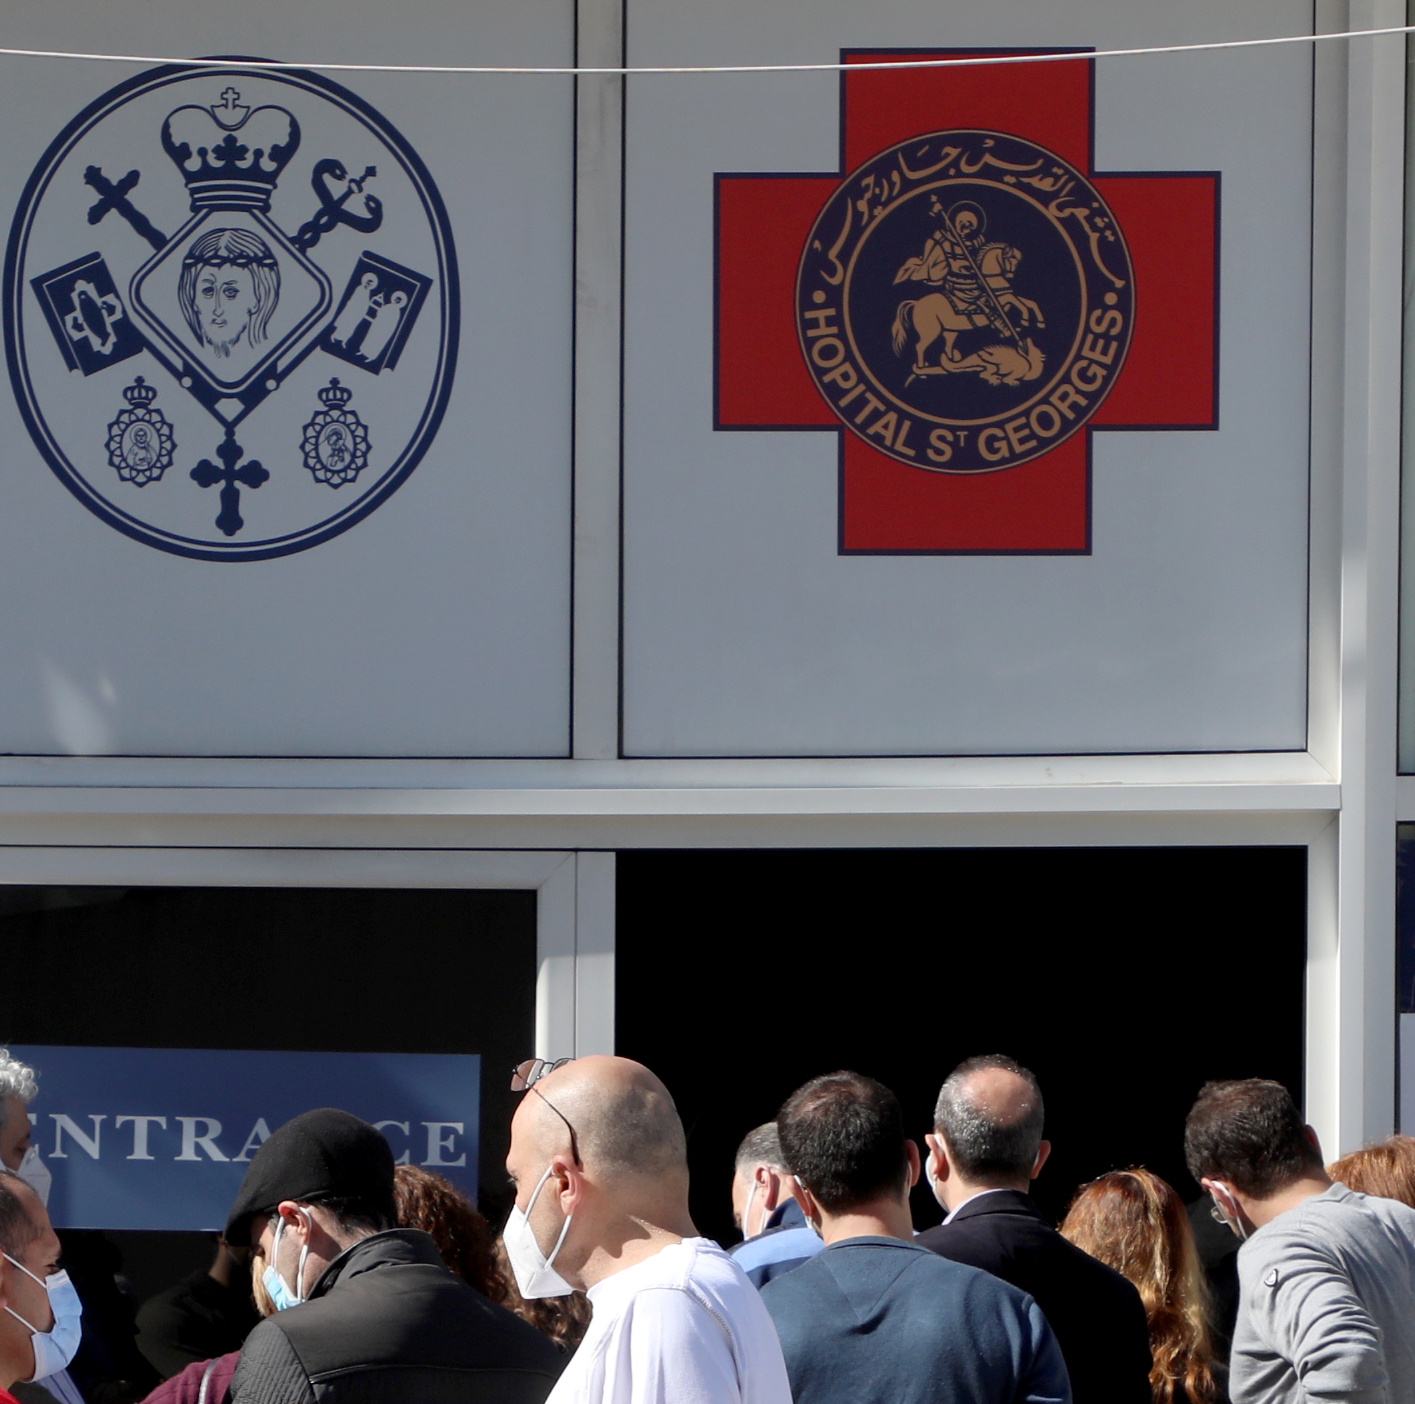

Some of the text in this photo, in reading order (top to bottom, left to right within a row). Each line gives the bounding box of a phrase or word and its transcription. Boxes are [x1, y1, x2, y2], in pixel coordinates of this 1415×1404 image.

[804, 307, 916, 458] HOPITAL
[978, 308, 1123, 461] GEORGES
[28, 1113, 467, 1167] NTRACE
